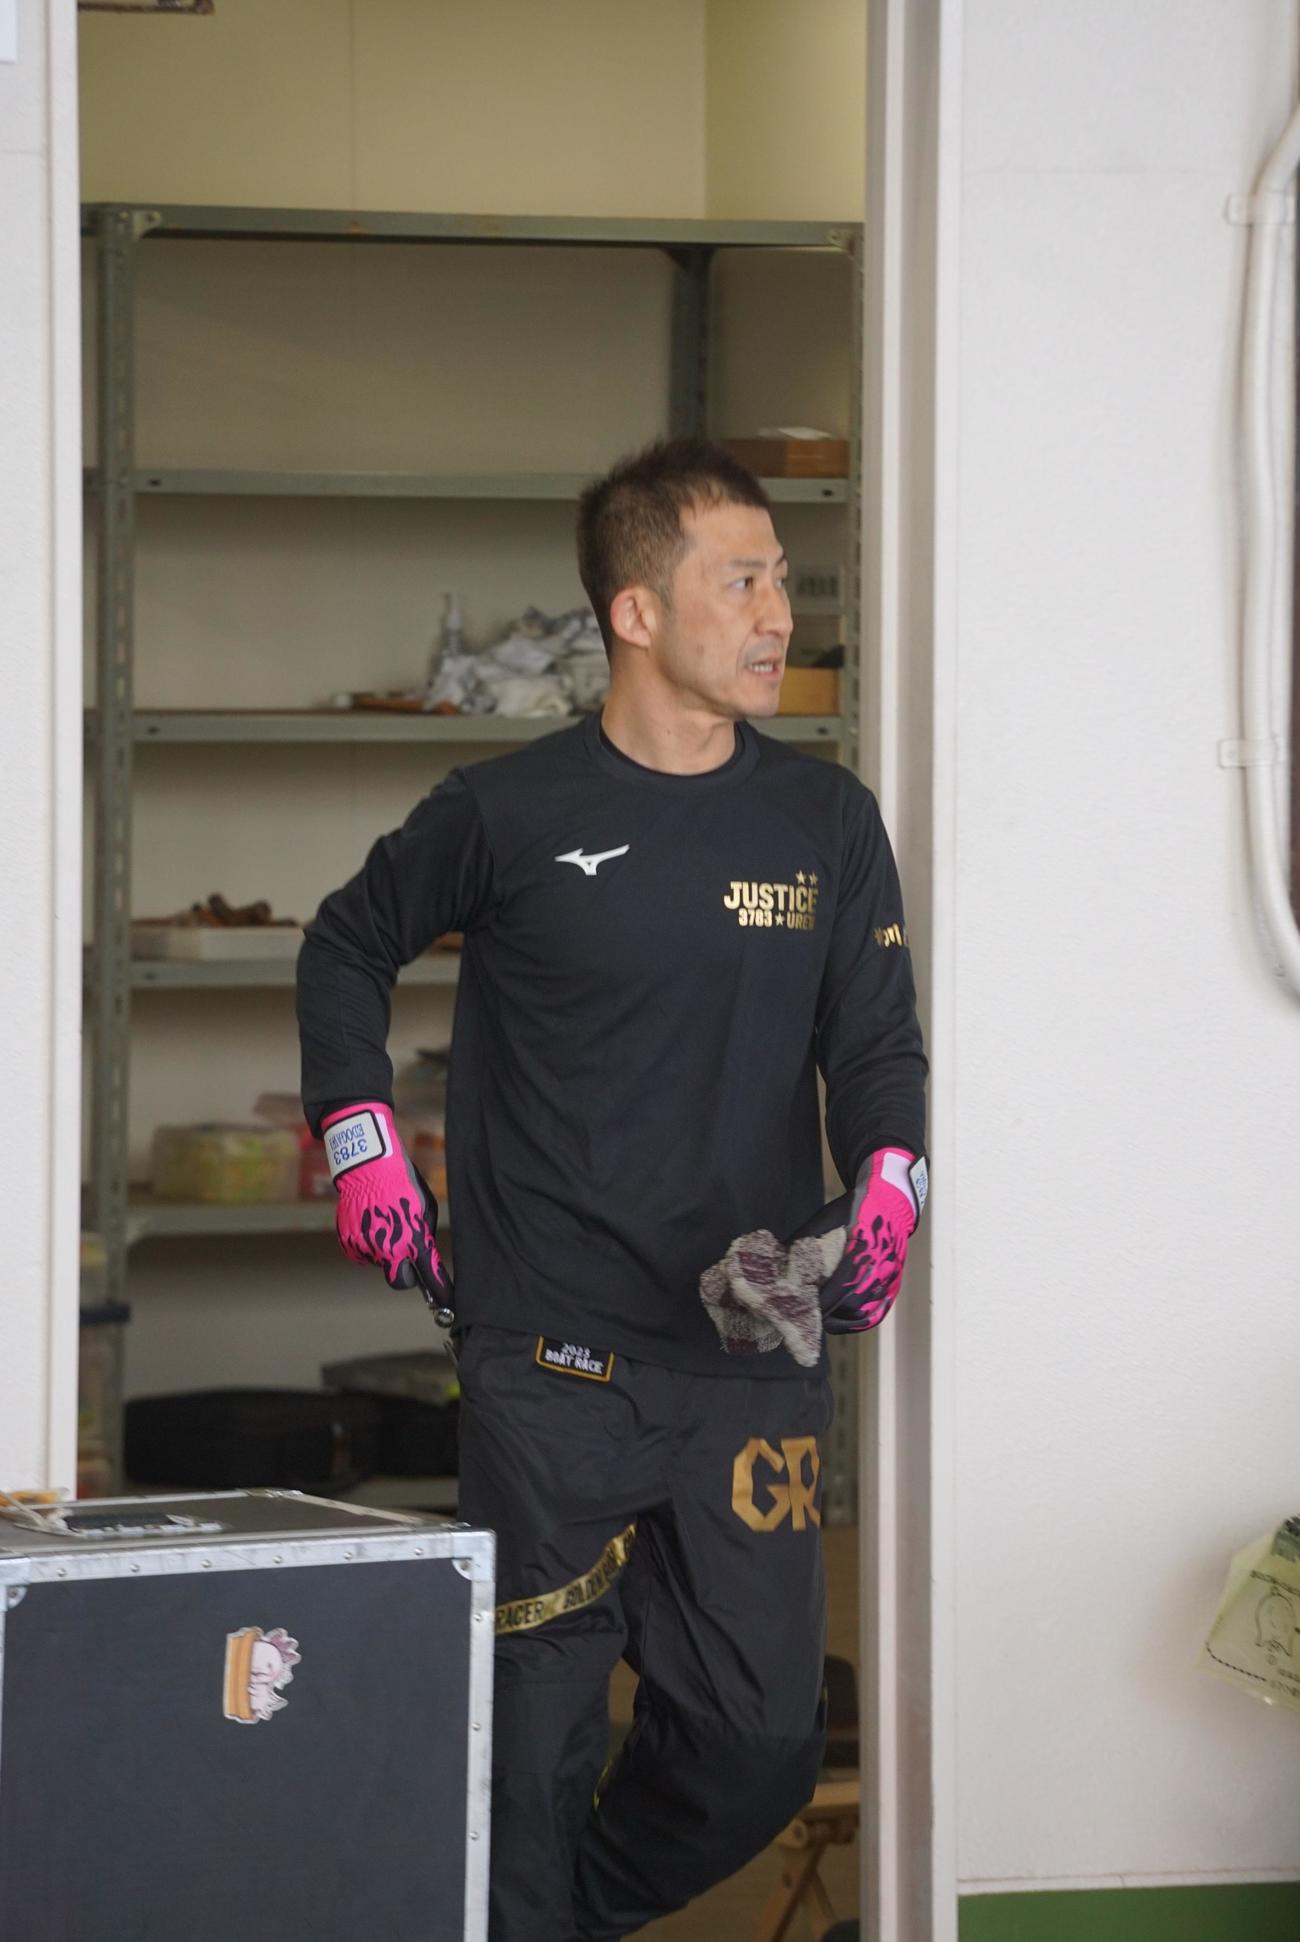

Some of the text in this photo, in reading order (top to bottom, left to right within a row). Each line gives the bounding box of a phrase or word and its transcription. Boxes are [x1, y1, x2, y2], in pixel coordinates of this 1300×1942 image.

[723, 880, 818, 913] JUSTICE
[738, 908, 773, 927] 3783
[333, 1138, 368, 1166] 3783
[545, 1348, 604, 1375] BOAT RACE
[731, 1436, 821, 1531] GR
